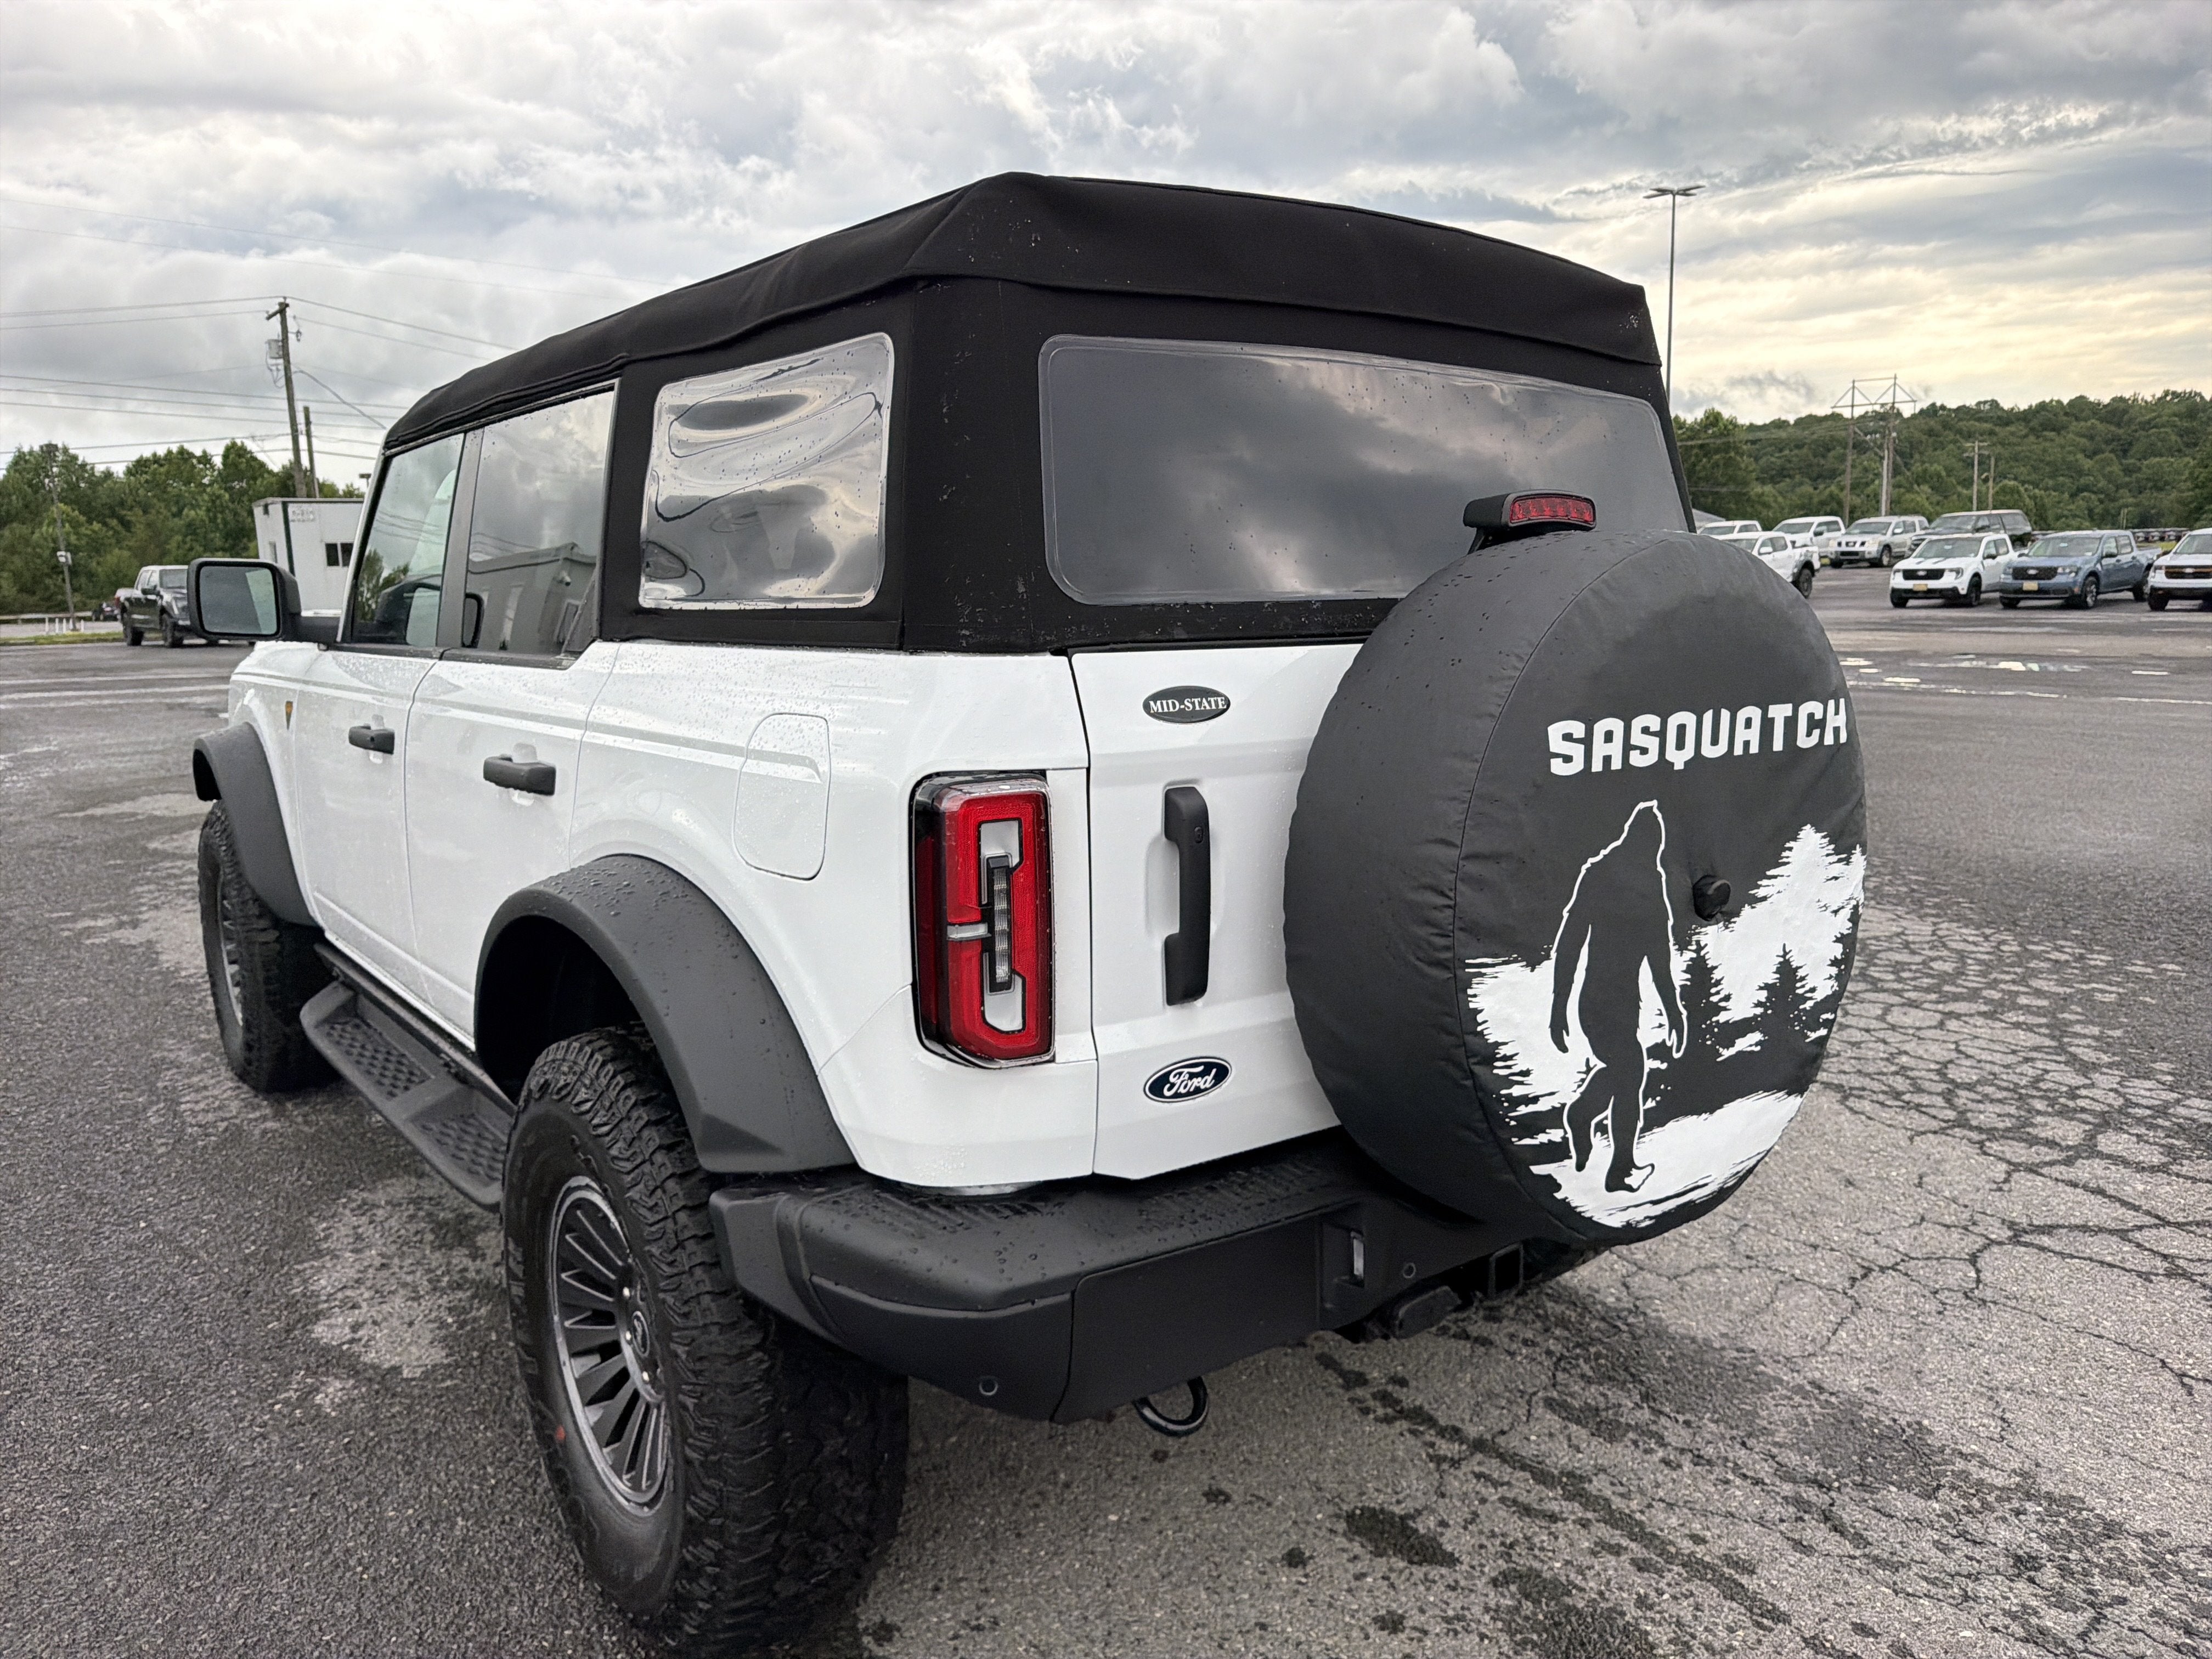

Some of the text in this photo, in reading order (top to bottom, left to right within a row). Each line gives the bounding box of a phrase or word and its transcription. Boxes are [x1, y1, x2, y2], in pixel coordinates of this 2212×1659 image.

[1148, 697, 1227, 713] MID-STATE
[1547, 698, 1847, 776] SASQUATCH
[1163, 1065, 1217, 1097] Ford
